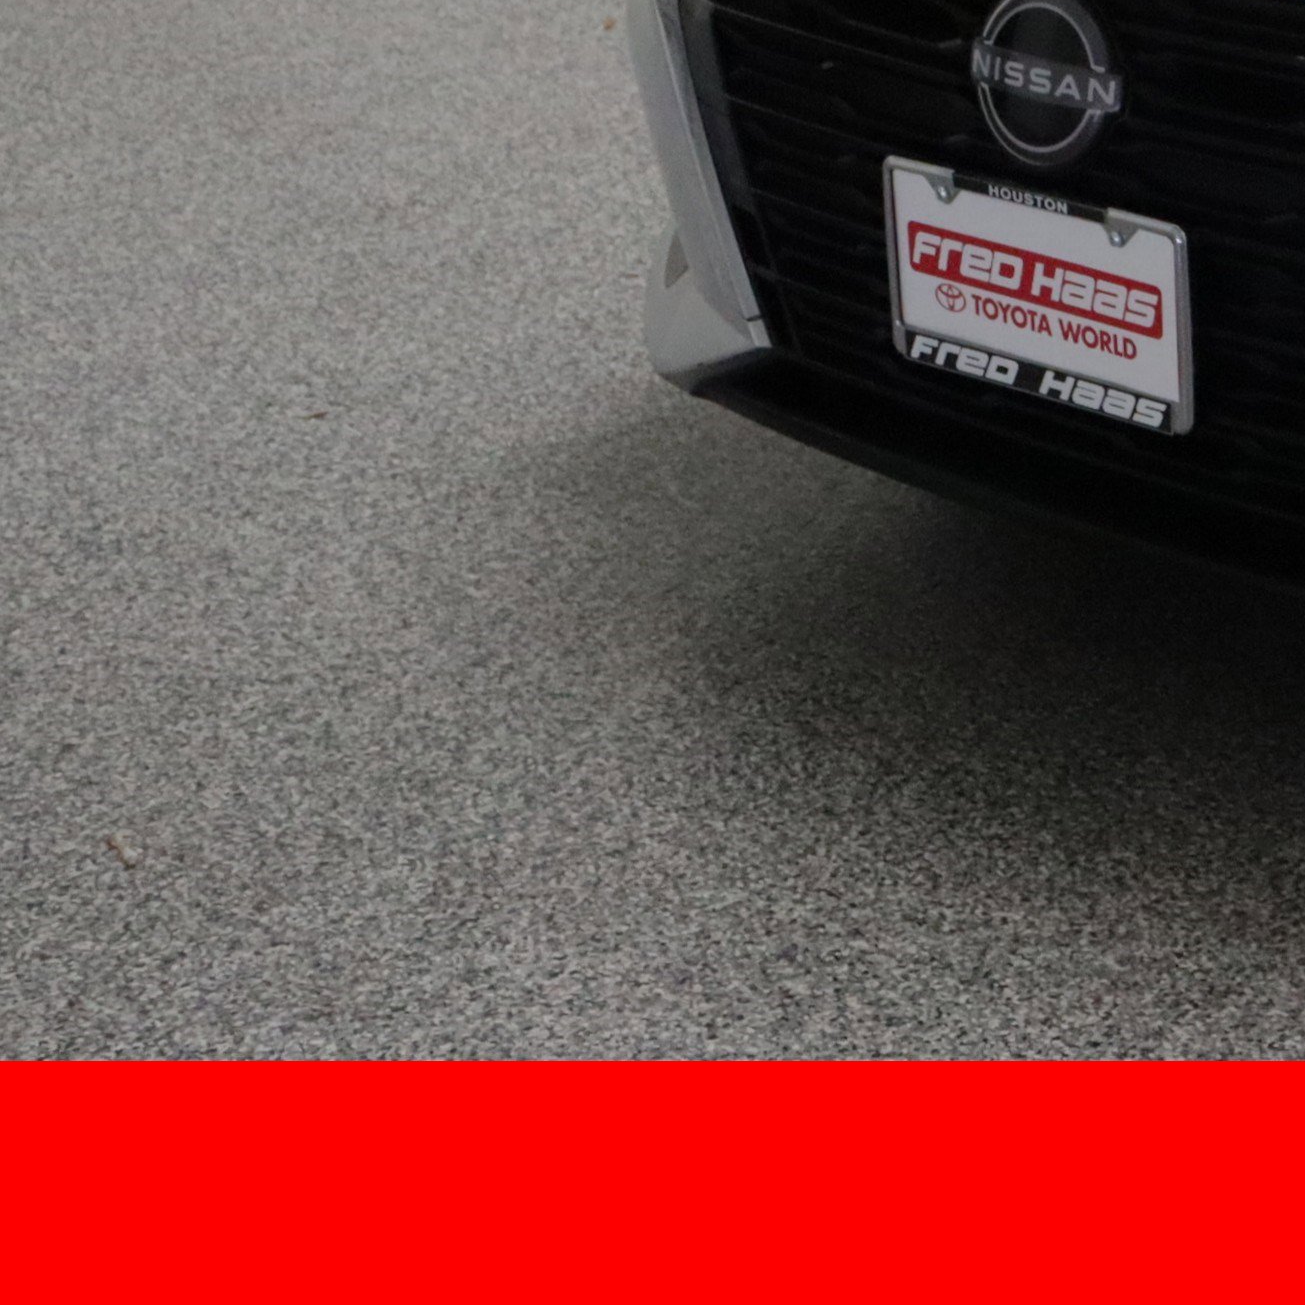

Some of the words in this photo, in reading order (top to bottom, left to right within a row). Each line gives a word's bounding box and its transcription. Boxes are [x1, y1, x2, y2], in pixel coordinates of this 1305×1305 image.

[972, 48, 1117, 105] NISSAN
[988, 184, 1068, 215] HOUSTON
[1031, 261, 1159, 329] Haas
[972, 294, 1053, 337] TOYOTA
[1058, 318, 1138, 361] WORLD
[1038, 370, 1168, 429] Haas
